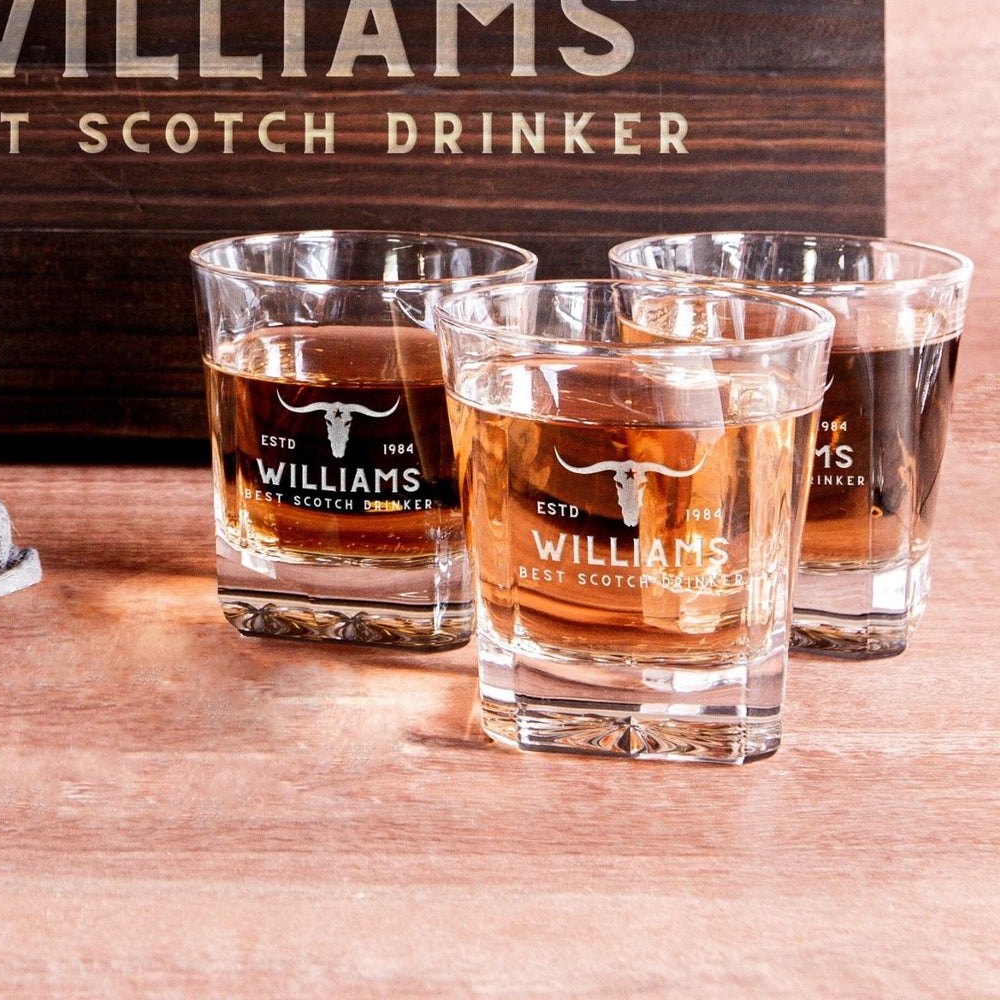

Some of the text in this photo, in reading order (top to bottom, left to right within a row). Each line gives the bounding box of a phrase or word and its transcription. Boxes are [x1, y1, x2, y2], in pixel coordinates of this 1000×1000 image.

[77, 110, 336, 156] SCOTCH
[386, 110, 690, 155] DRINKER
[821, 421, 847, 431] 984
[261, 434, 296, 449] ESTD
[383, 443, 414, 455] 1984
[256, 458, 421, 493] WILLIAMS
[244, 488, 433, 511] BEST SCOTCH DRINKER
[536, 501, 579, 518] ESTD
[685, 507, 722, 522] 1984
[531, 529, 730, 568] WILLIAMS
[519, 565, 565, 584] BEST
[577, 573, 649, 589] SCOTCH
